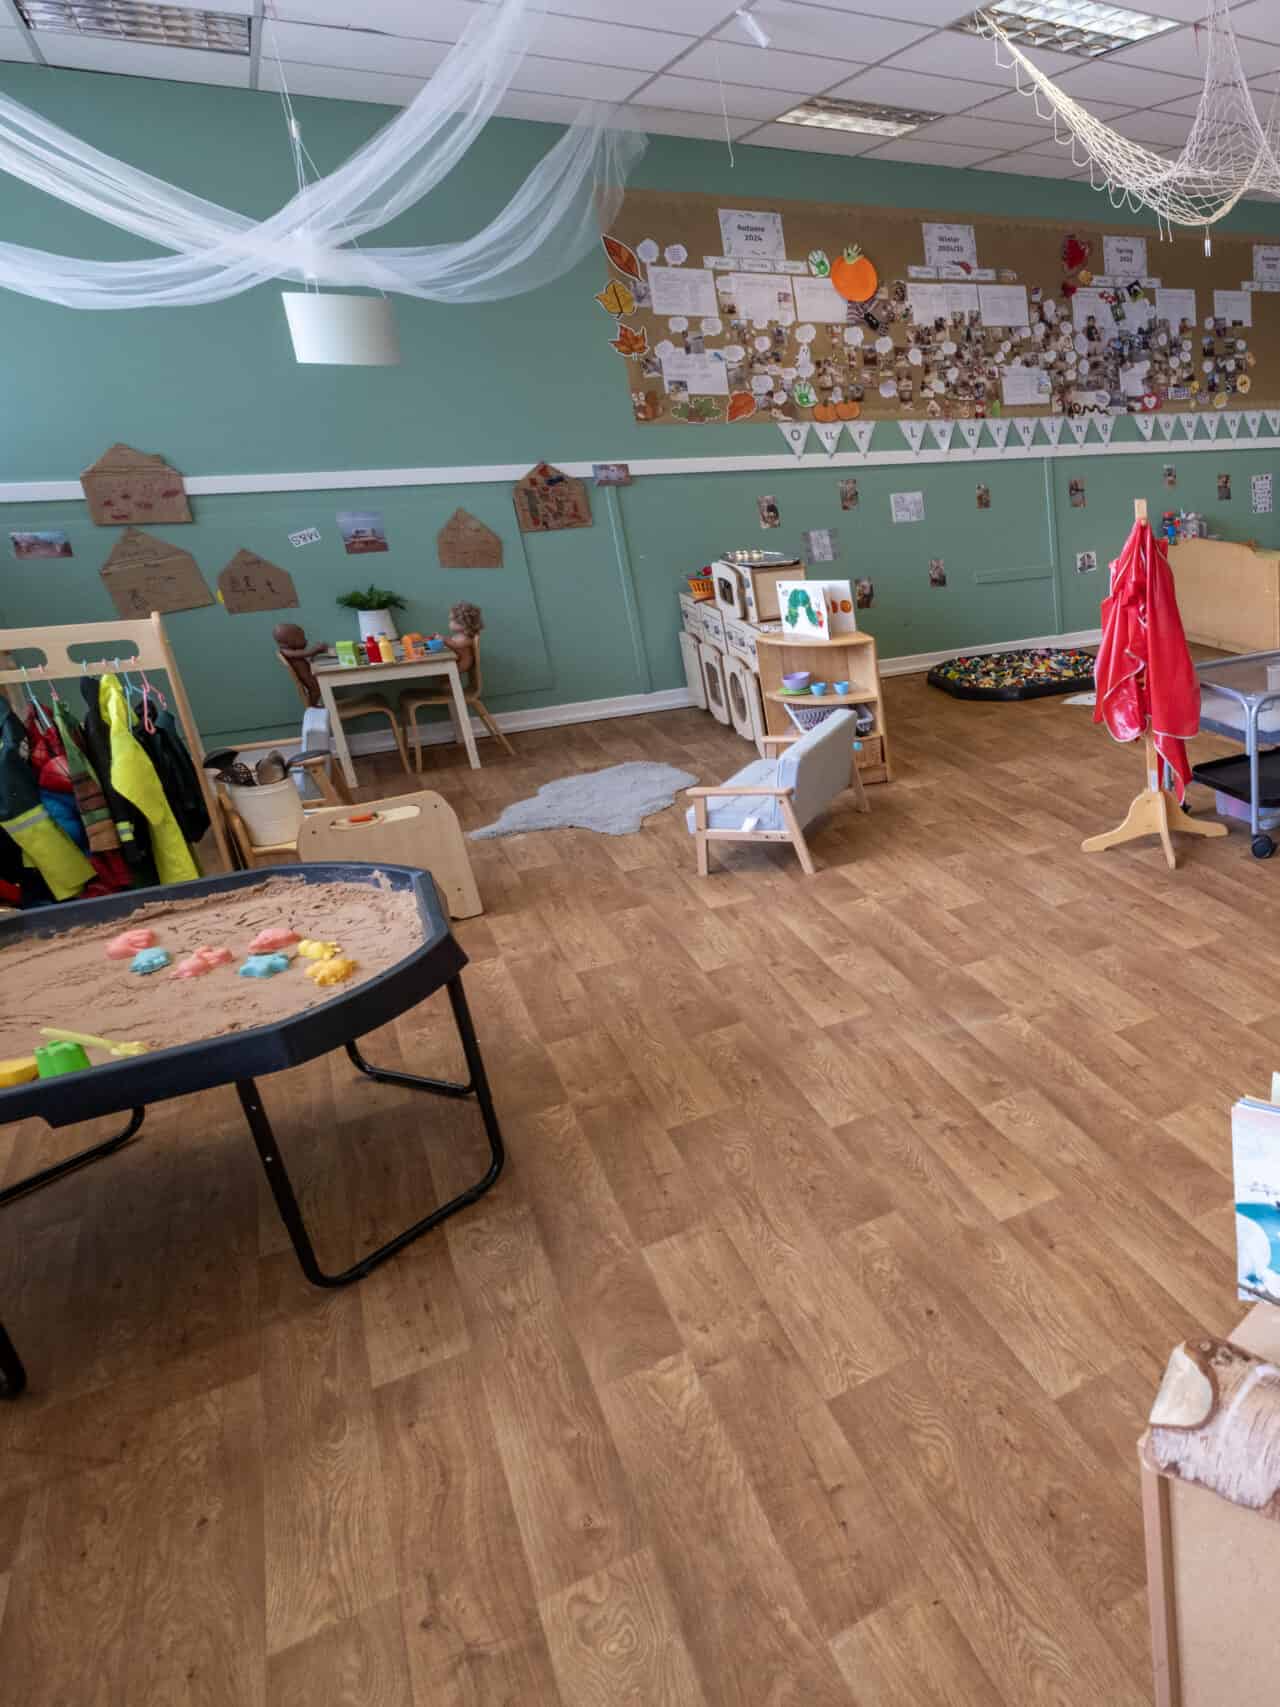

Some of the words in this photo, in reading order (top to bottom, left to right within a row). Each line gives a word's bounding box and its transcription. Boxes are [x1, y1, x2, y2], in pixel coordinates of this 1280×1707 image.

[790, 429, 866, 441] Our
[910, 423, 1109, 438] Learning
[1143, 417, 1278, 430] Journey
